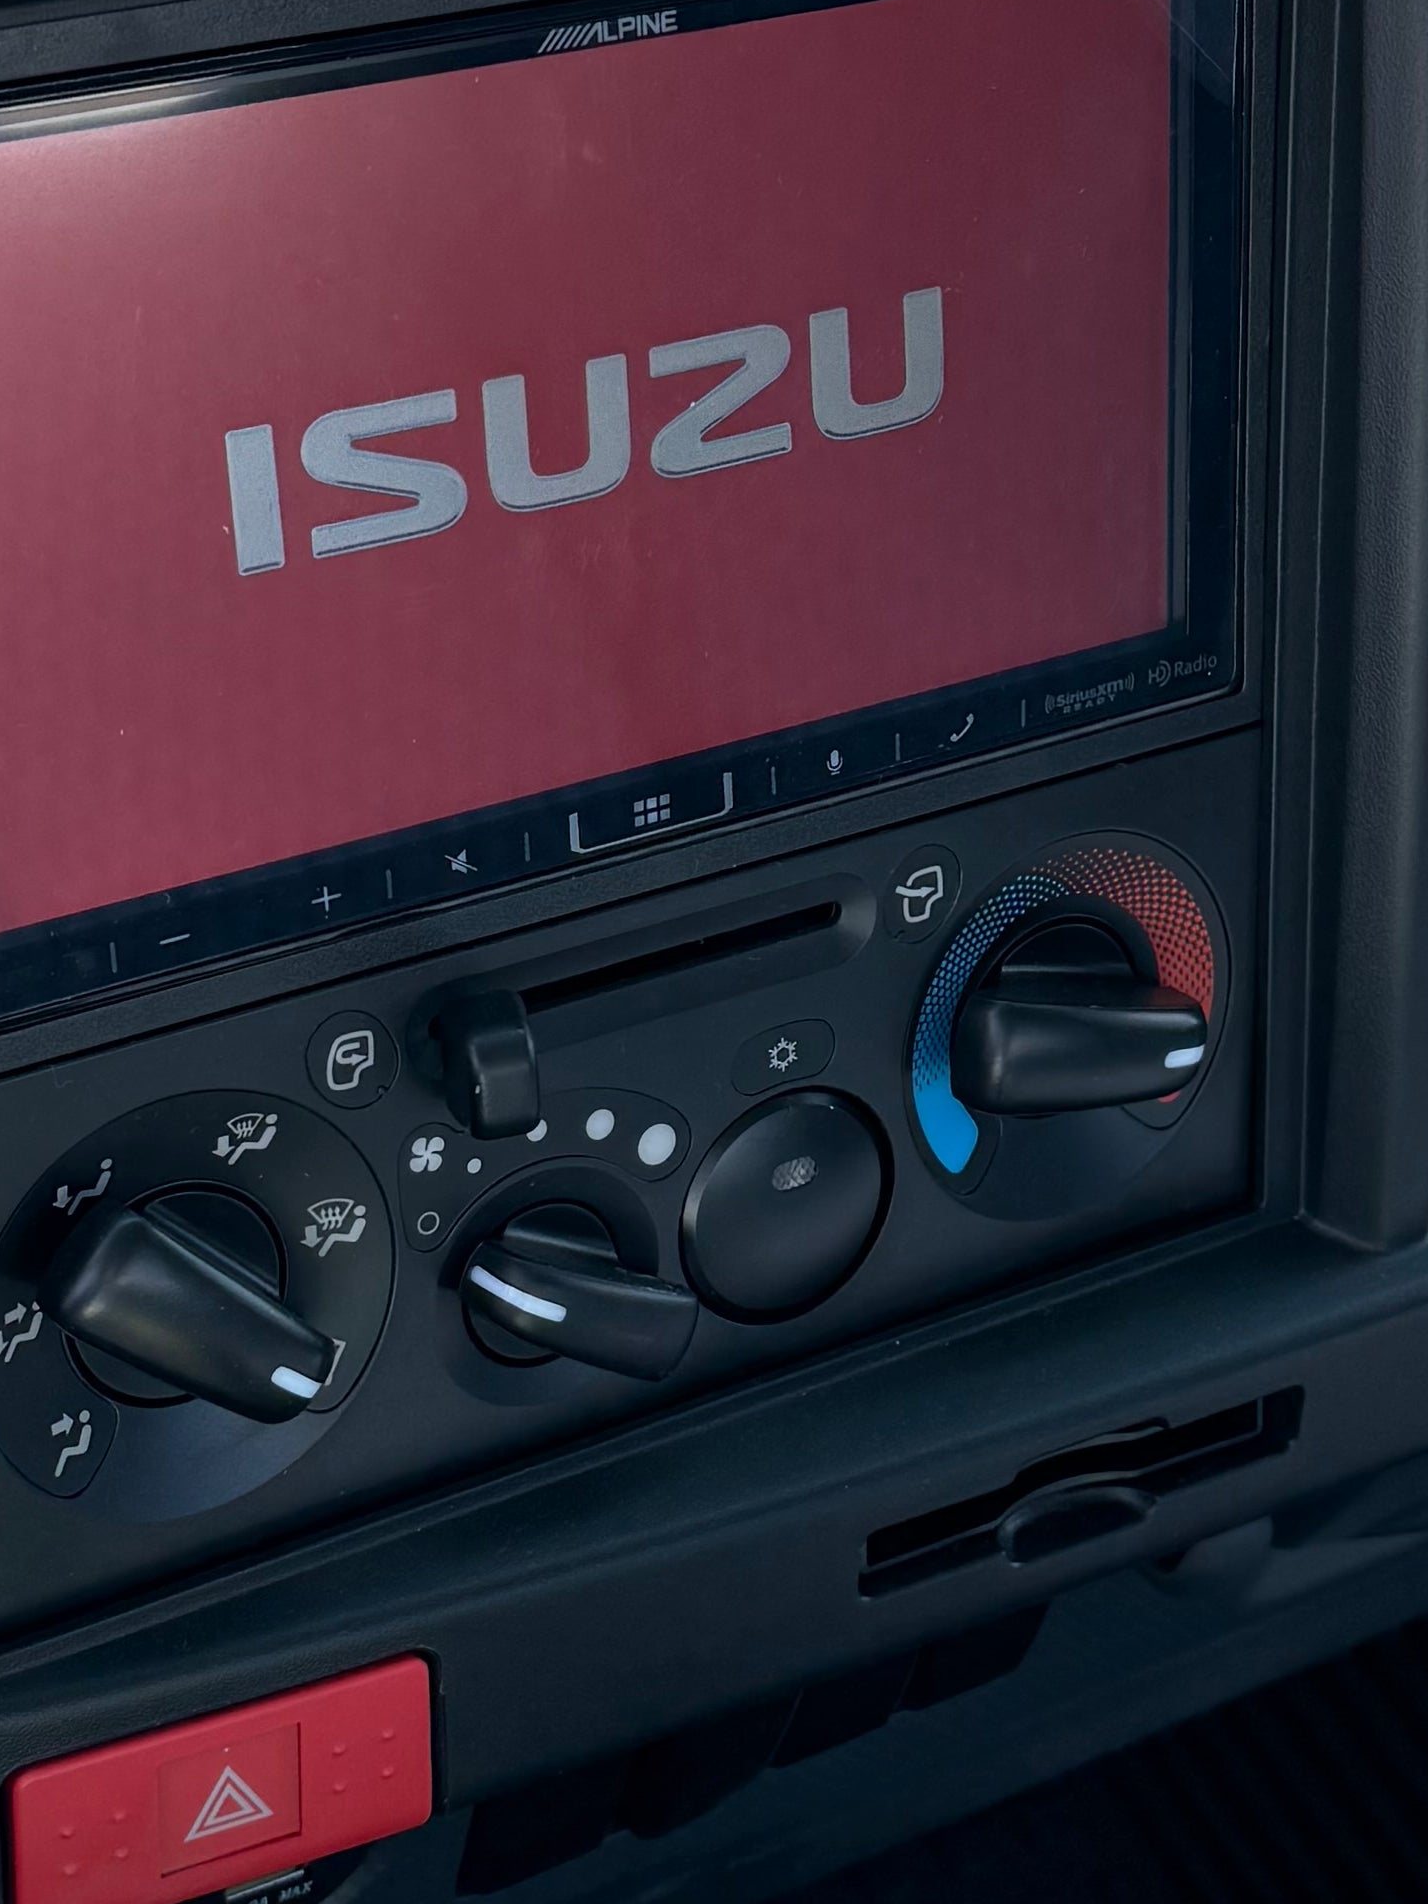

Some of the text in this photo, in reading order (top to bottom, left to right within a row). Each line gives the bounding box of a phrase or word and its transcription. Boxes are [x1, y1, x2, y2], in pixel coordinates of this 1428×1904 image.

[581, 9, 679, 47] ALPINE
[225, 286, 944, 576] ISUZU
[1174, 654, 1218, 678] Radio
[1063, 694, 1116, 714] READY
